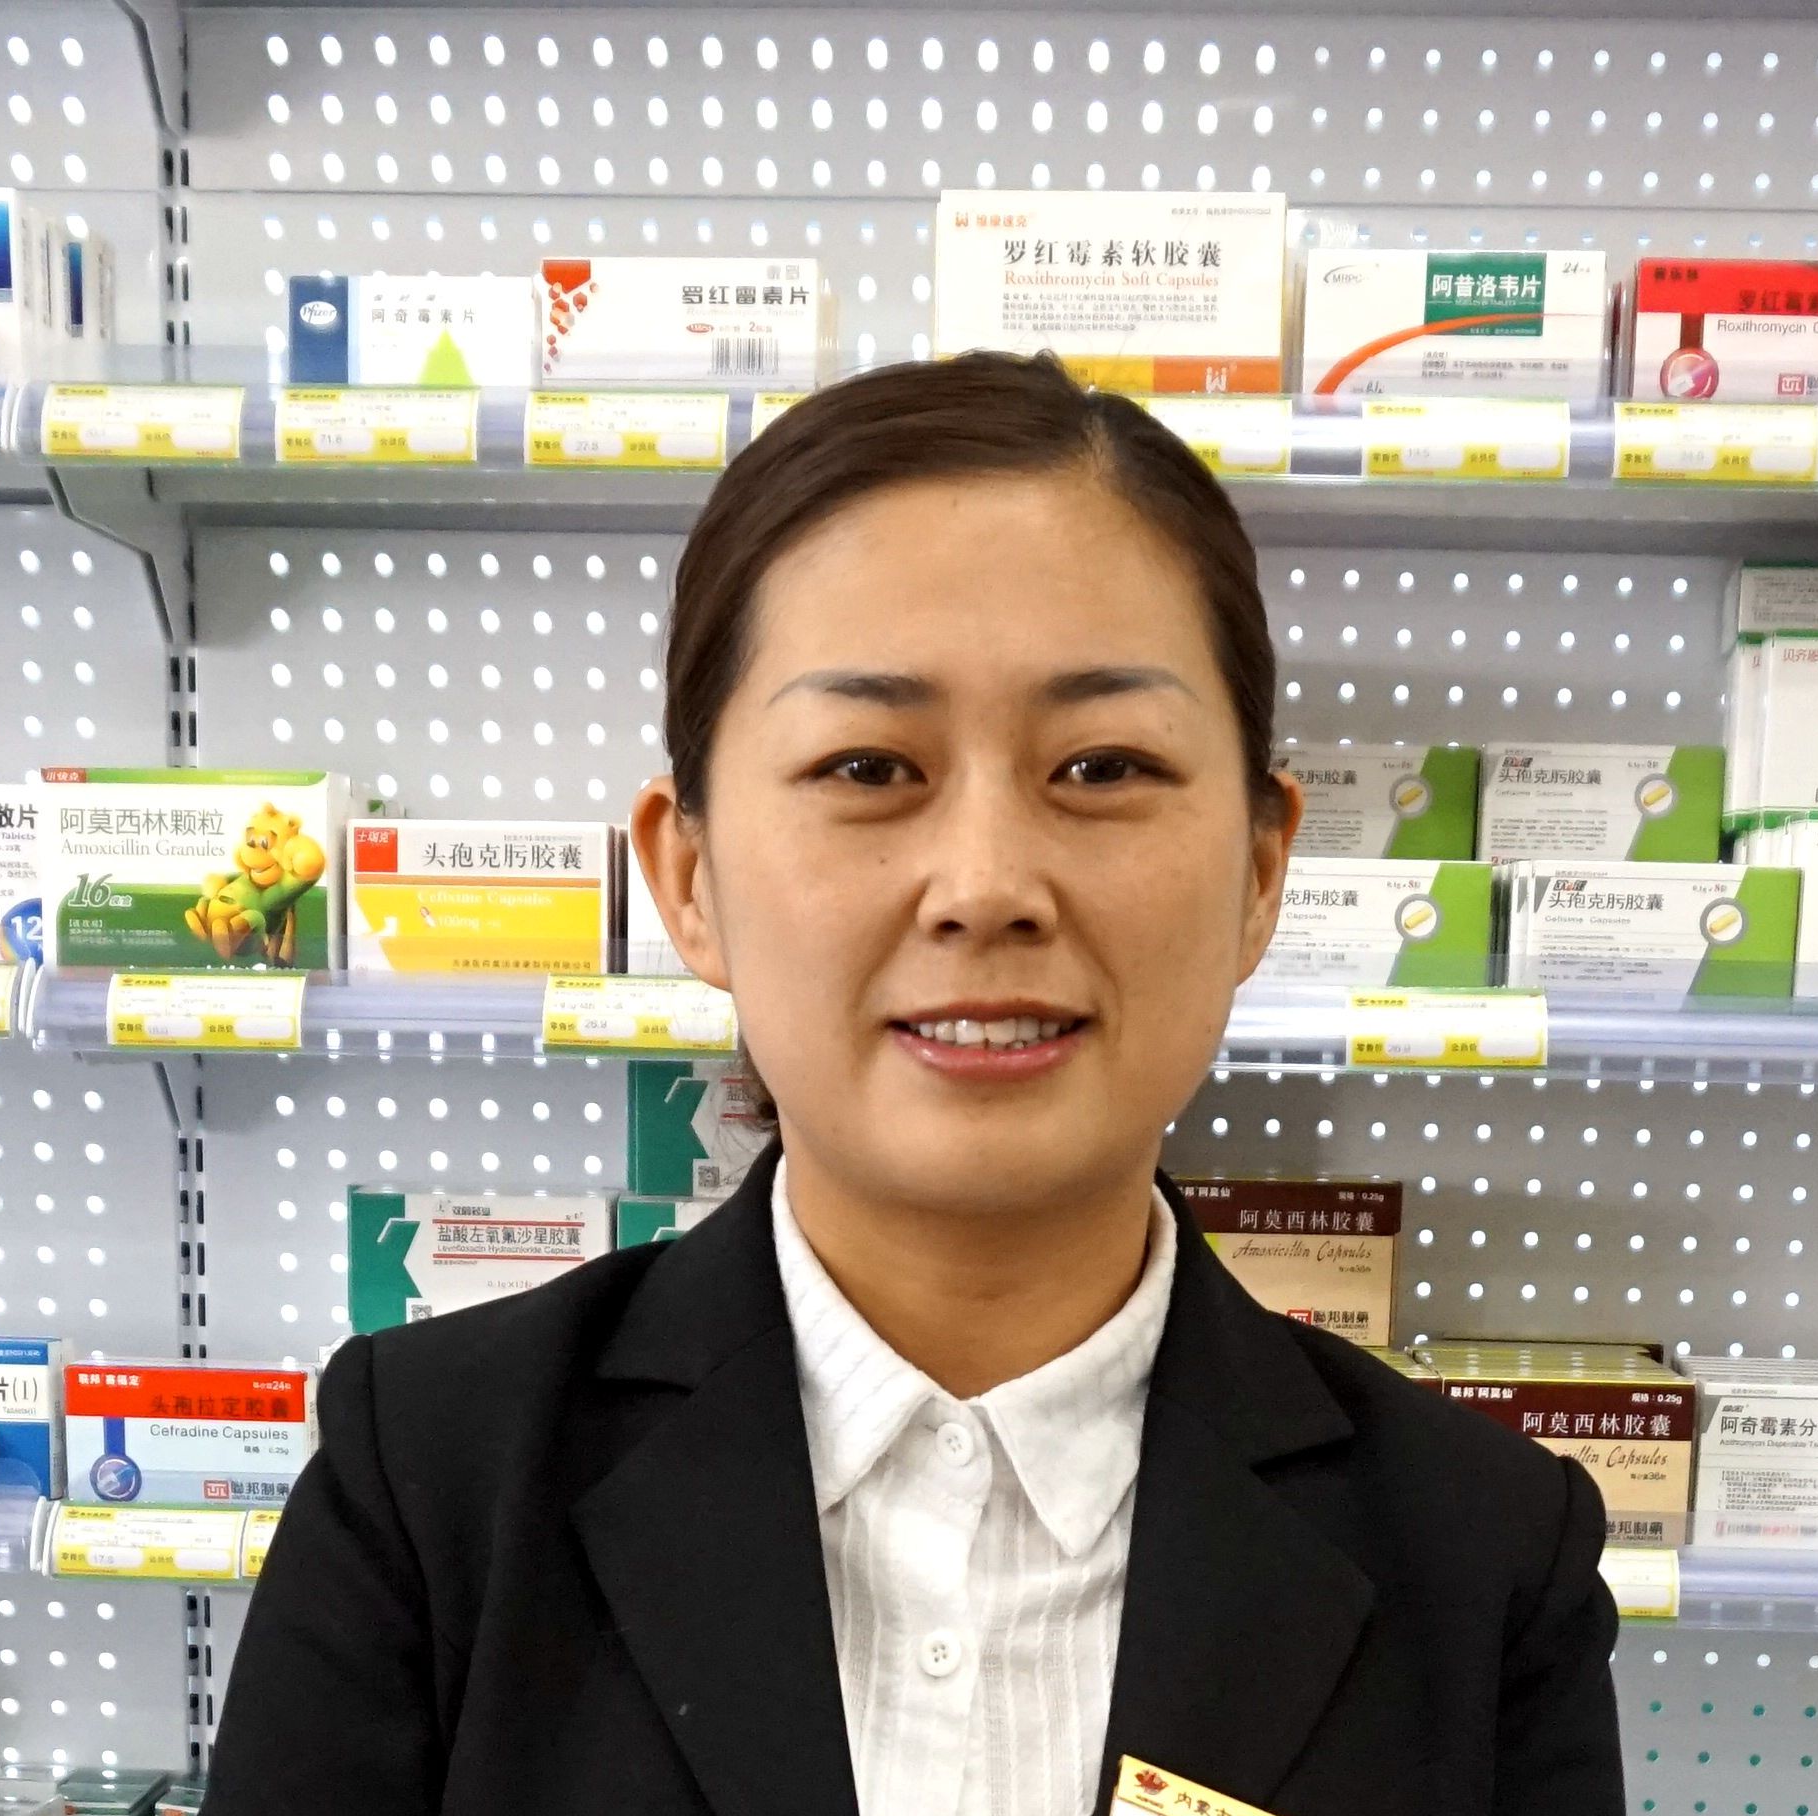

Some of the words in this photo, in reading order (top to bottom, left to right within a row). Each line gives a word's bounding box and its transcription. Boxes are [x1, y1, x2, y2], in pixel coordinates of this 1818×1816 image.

[1003, 239, 1223, 269] 罗红霉素软胶囊
[1003, 270, 1116, 291] Roxithromycin
[1120, 270, 1151, 287] Soft
[1156, 271, 1221, 291] Capsules
[1431, 272, 1543, 300] 阿昔洛韦片
[682, 284, 811, 306] 罗红霉素片
[371, 306, 476, 325] 阿奇霉素片
[1716, 318, 1808, 337] Roxithromycin
[1291, 767, 1358, 788] 克肟胶囊
[1497, 767, 1602, 787] 头孢克肟胶囊
[60, 807, 226, 838] 阿莫西林颗粒
[61, 839, 151, 856] Amoxicillin
[155, 839, 226, 858] Granules
[422, 843, 585, 871] 头孢克肟胶囊
[1282, 888, 1360, 909] 克肟胶囊
[1547, 891, 1666, 913] 头孢克肟胶囊
[1238, 1208, 1375, 1233] 阿莫西林胶囊
[436, 1224, 582, 1246] 盐酸左氧氟沙星胶囊
[149, 1423, 219, 1438] Cefradine
[222, 1425, 290, 1442] Capsules
[1521, 1411, 1672, 1437] 阿莫西林胶囊
